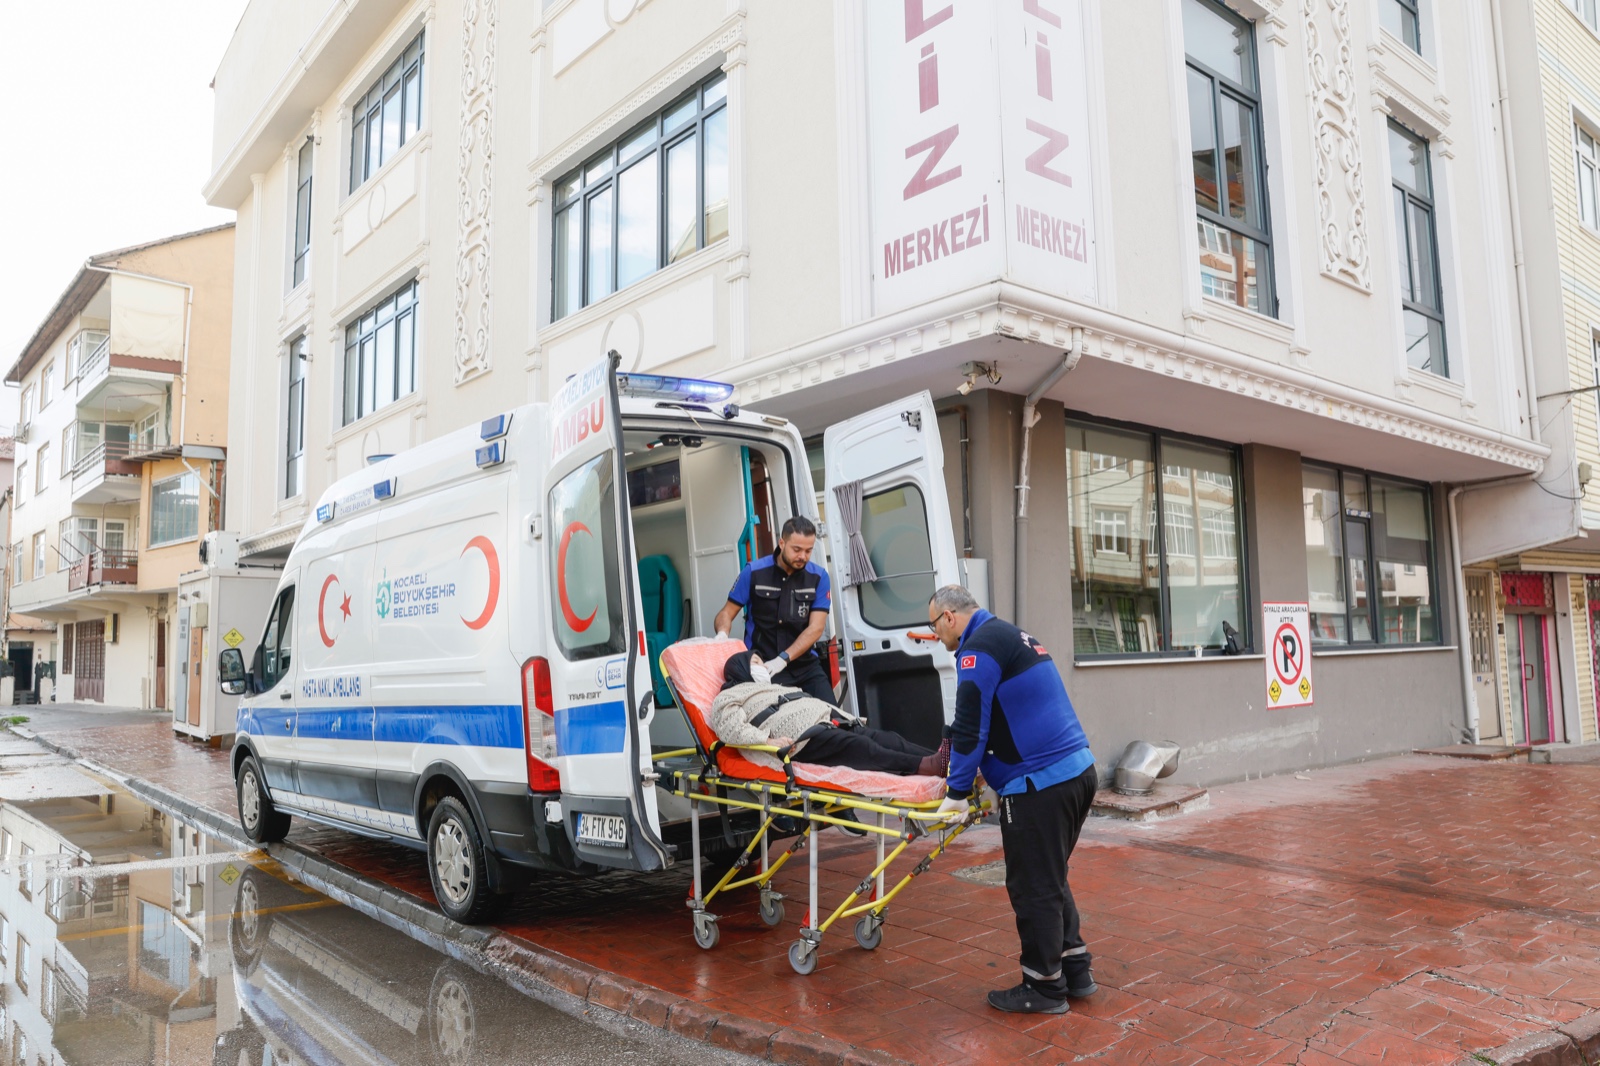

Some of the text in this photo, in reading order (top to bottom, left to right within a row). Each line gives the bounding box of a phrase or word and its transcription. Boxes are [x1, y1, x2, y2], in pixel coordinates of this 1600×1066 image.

[884, 194, 990, 279] MERKEZİ
[1015, 203, 1088, 264] MERKEZİ
[552, 396, 604, 460] AMBU
[393, 573, 428, 589] KOCAELİ
[393, 583, 456, 605] BÜYÜKŞEHİR
[393, 602, 439, 619] BELEDİYESİ
[302, 679, 317, 698] HASTA
[581, 815, 624, 840] 34 FTK 946
